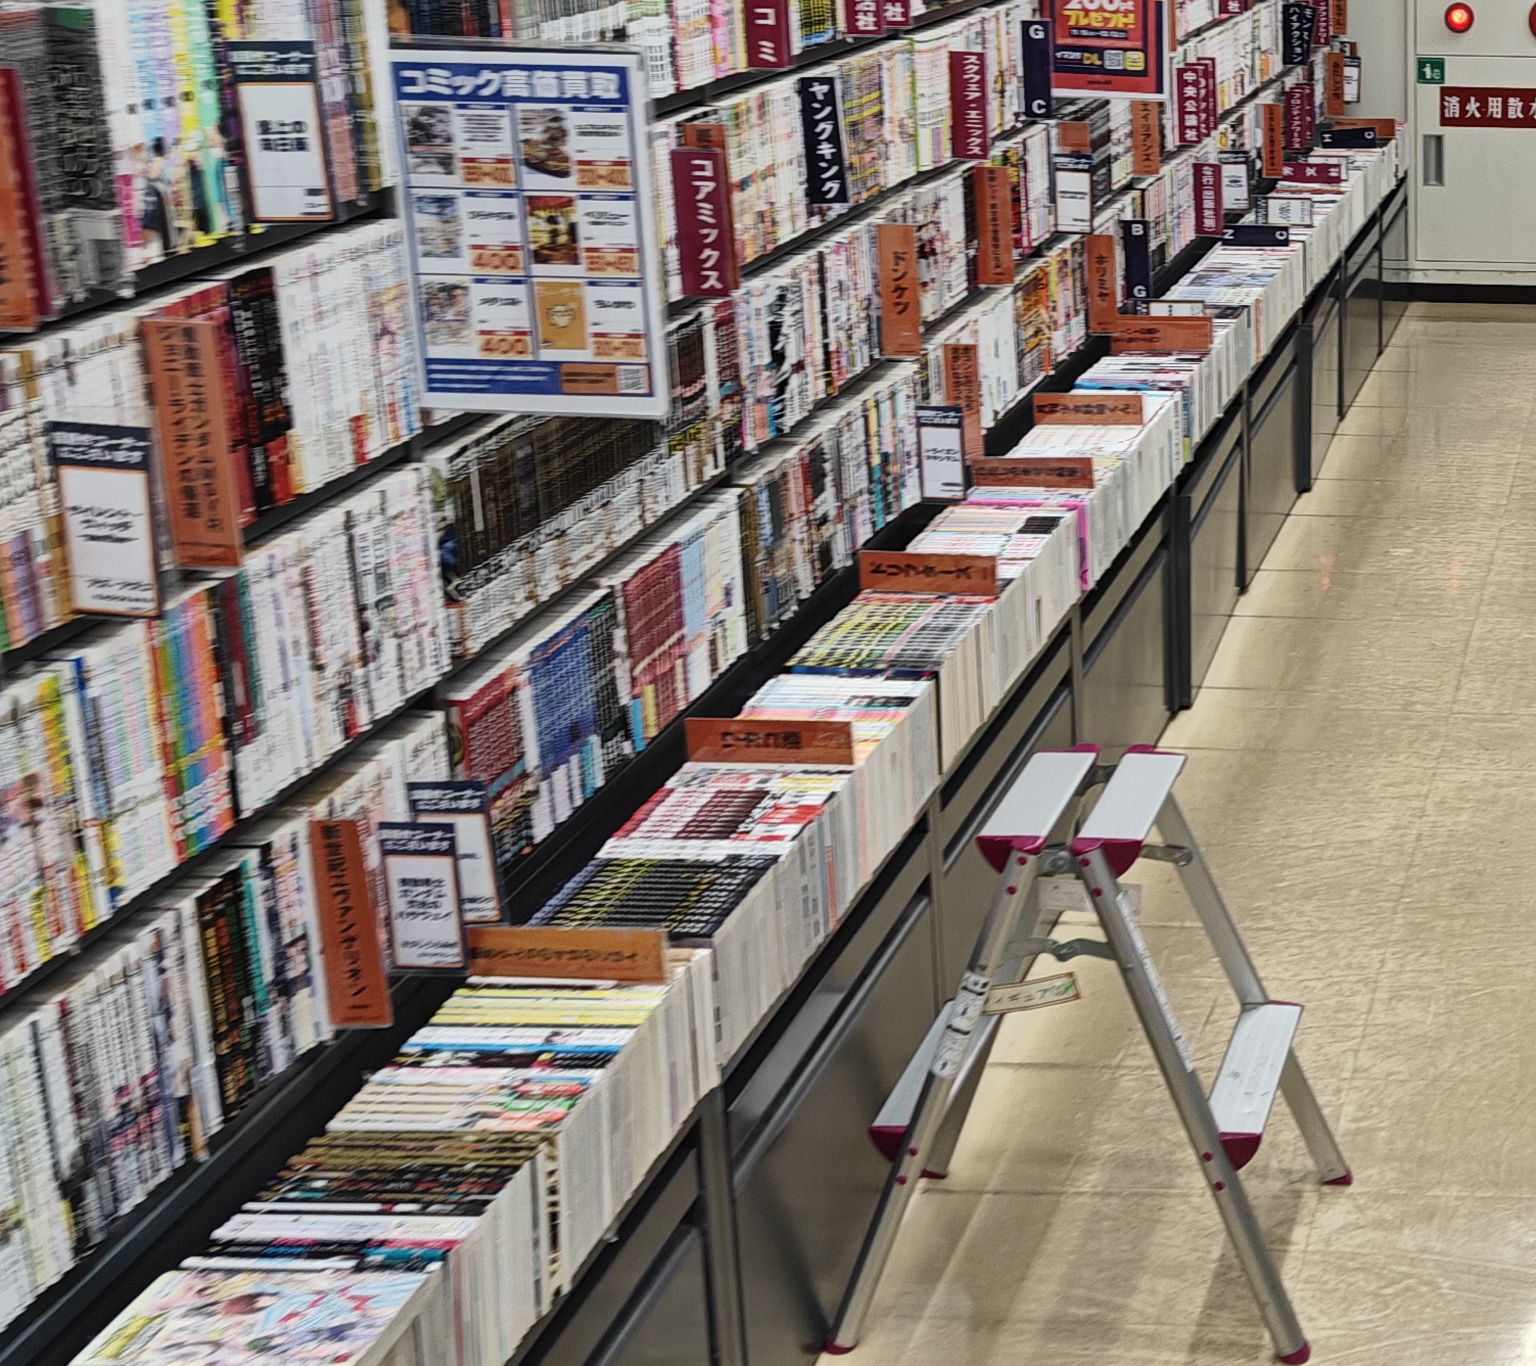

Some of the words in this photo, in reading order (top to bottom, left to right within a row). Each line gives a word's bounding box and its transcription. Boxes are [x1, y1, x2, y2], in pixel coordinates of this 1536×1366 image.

[808, 82, 843, 199] ヤングキング
[963, 55, 985, 156] スクウェア・エニックス
[689, 159, 723, 290] コアミックス
